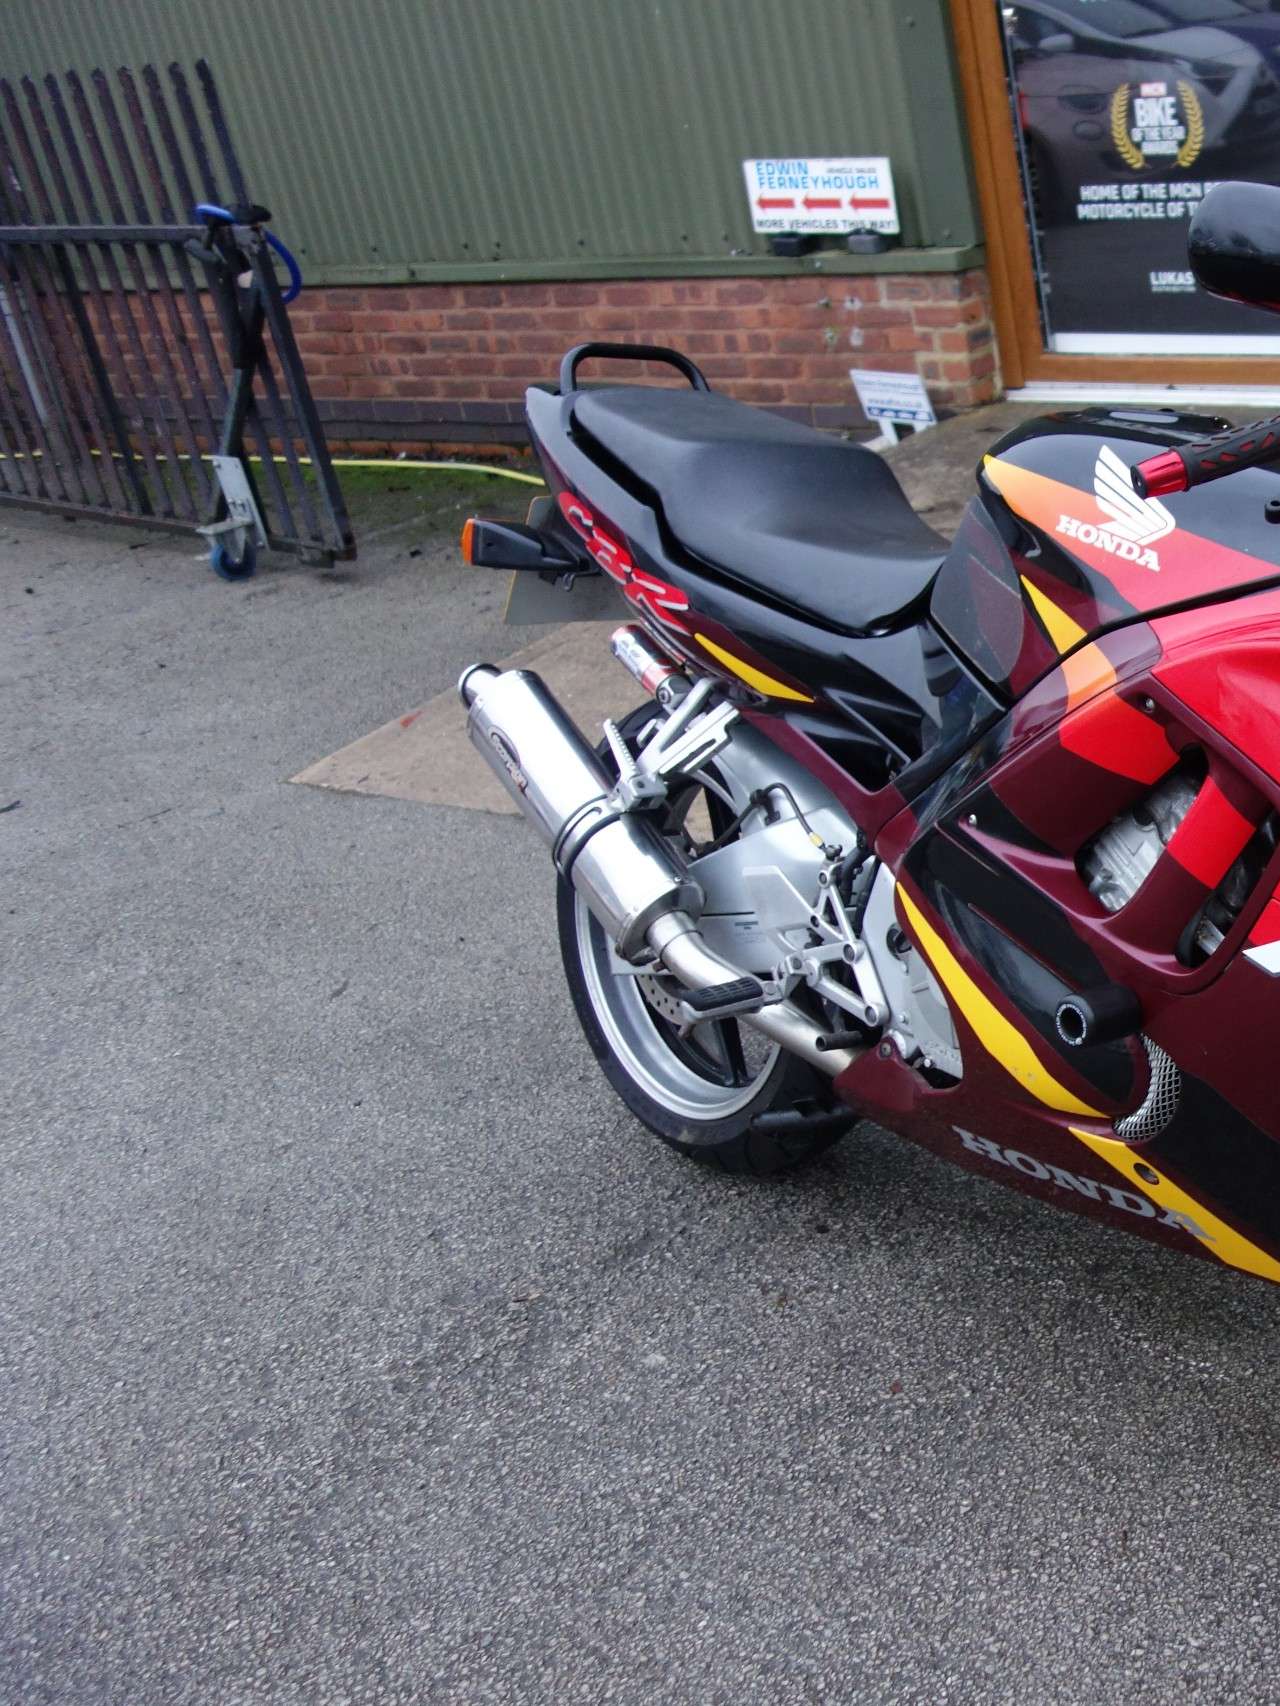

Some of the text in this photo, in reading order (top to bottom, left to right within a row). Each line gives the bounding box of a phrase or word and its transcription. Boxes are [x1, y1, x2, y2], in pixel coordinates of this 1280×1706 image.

[1134, 97, 1178, 127] BIKE
[756, 160, 808, 176] EDWIN
[758, 175, 880, 190] FERNEYHOUGH
[1080, 185, 1120, 200] HOME
[1121, 184, 1139, 199] OF
[1140, 183, 1167, 199] THE
[1168, 182, 1202, 198] MCN
[1077, 202, 1165, 219] MOTORCYCLE
[1166, 201, 1185, 217] OF
[756, 219, 784, 229] MORE
[789, 219, 838, 229] VEHICLES
[841, 219, 866, 229] THIS
[1150, 271, 1195, 285] LUKAS
[1055, 514, 1161, 572] HONDA
[952, 1125, 1217, 1244] HONDA
